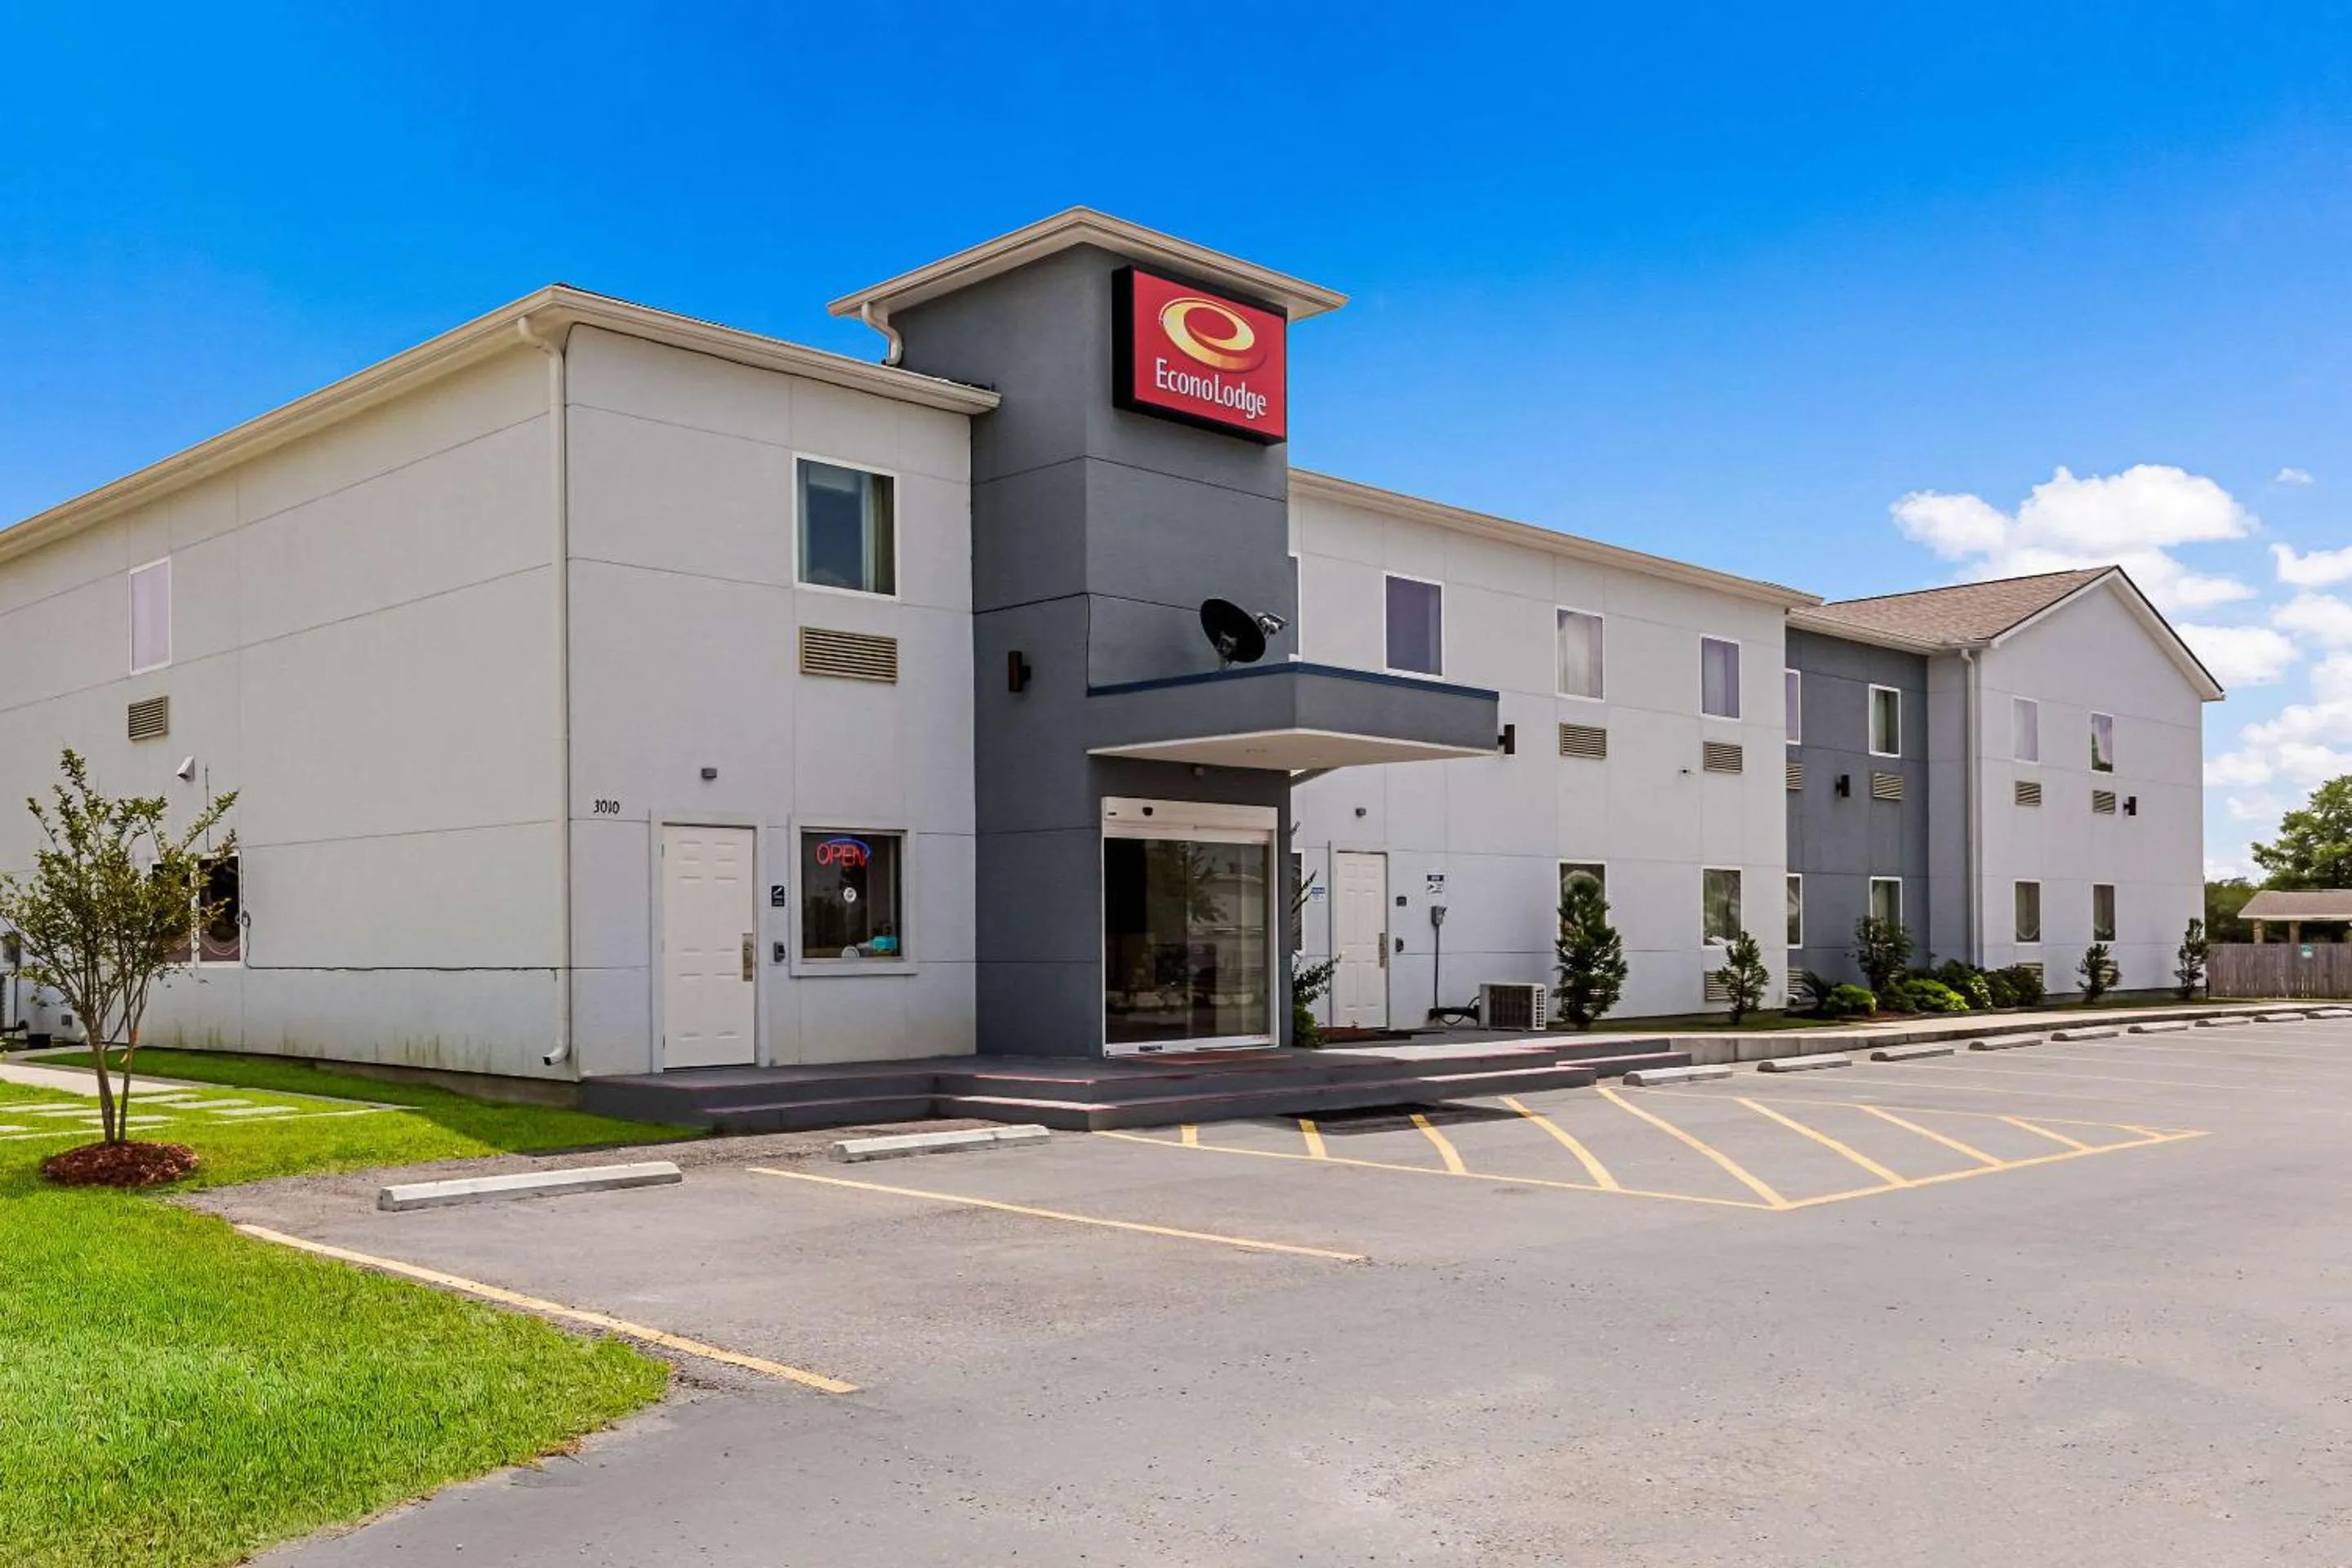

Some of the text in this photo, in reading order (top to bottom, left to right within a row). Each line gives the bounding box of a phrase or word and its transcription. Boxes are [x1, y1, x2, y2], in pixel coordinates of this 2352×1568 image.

[1156, 357, 1267, 419] EconoLodge
[594, 799, 620, 815] 3010
[817, 842, 866, 867] OPEN
